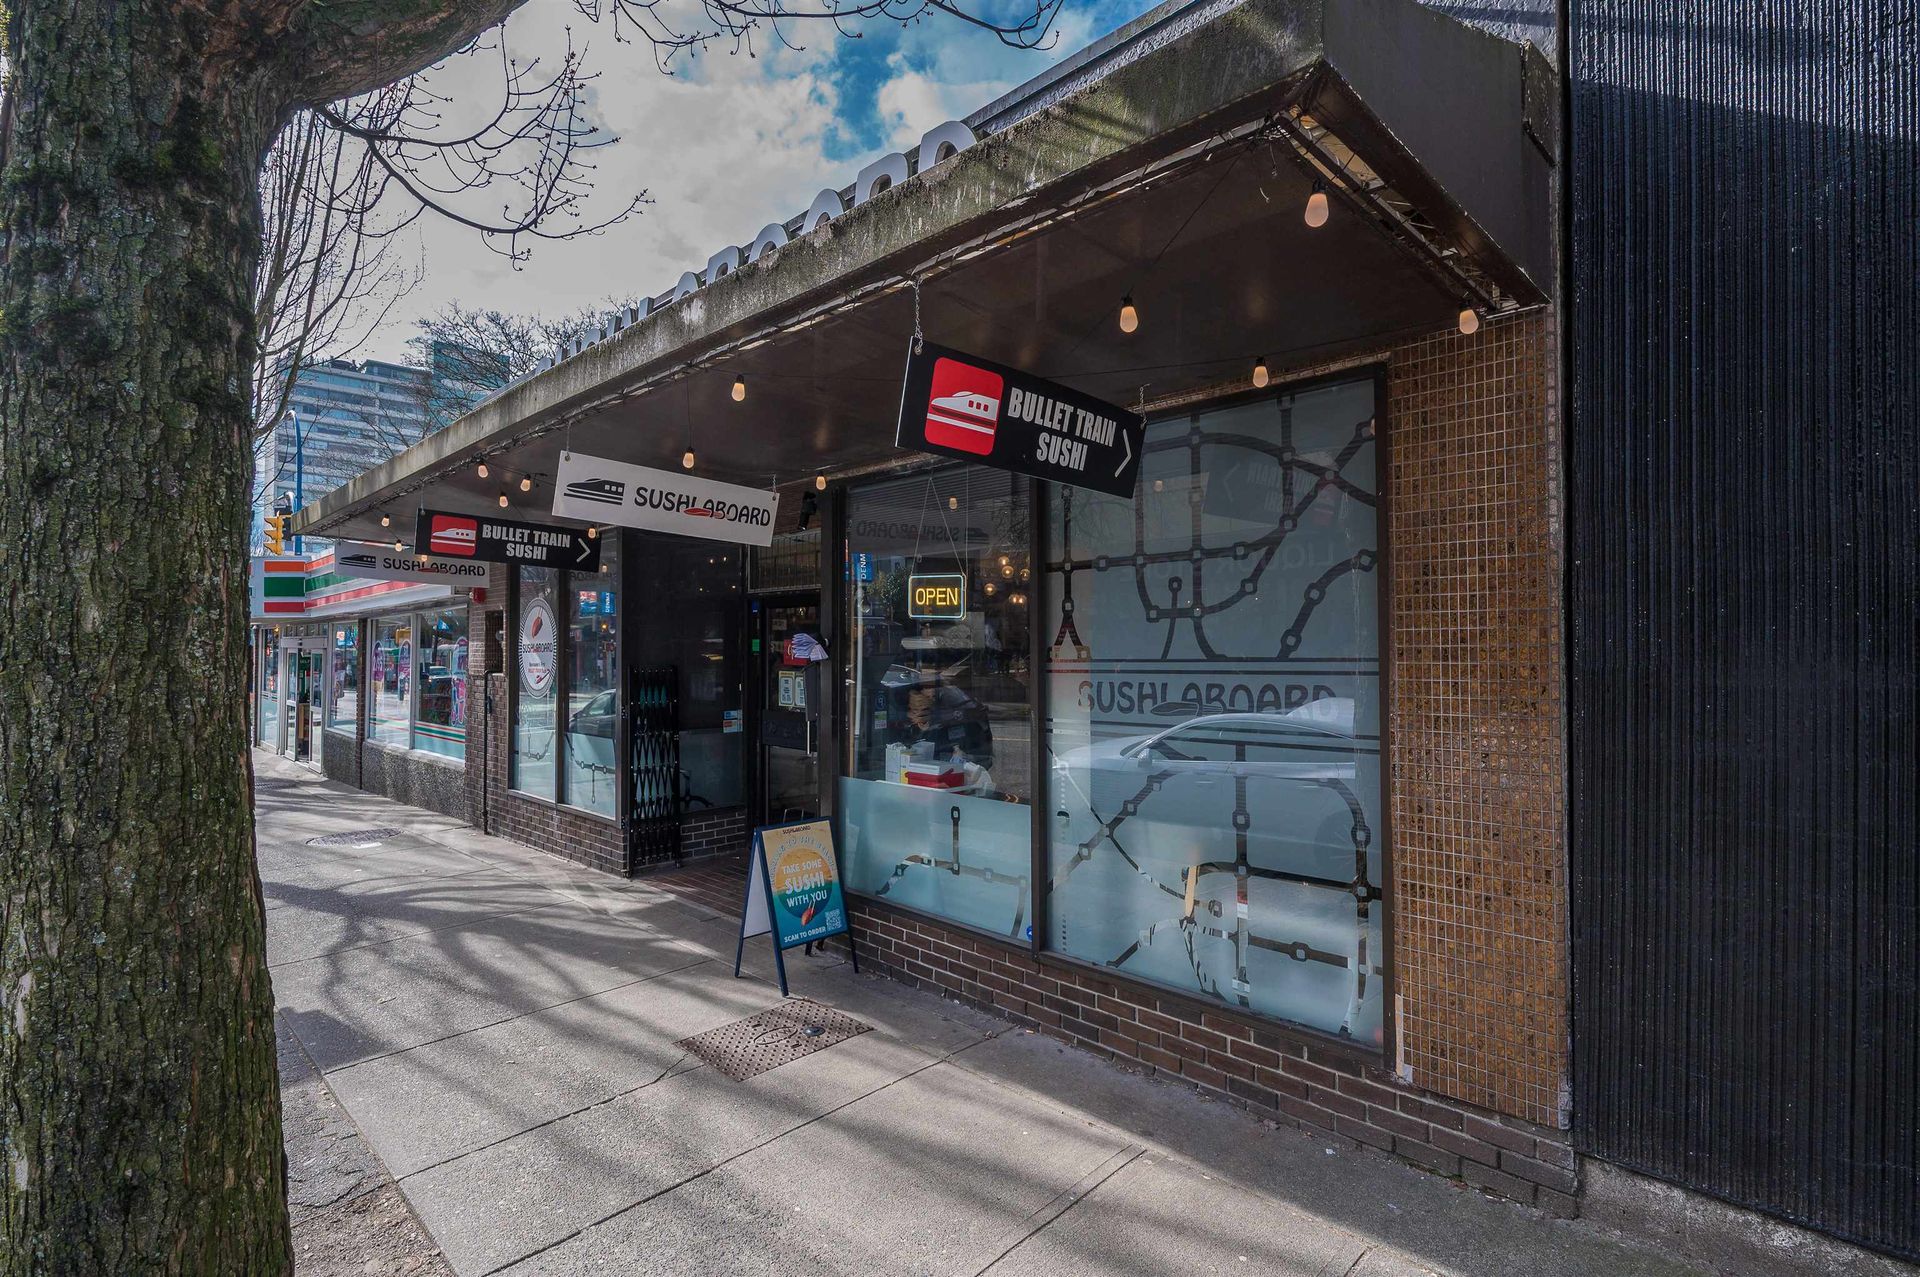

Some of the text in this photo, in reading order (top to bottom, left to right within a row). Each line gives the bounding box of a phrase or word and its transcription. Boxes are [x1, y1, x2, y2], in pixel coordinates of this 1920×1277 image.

[1007, 386, 1117, 448] BULLET TRAIN
[1036, 432, 1088, 471] SUSHI
[634, 486, 771, 527] SUSHI ABOARD
[482, 524, 571, 548] BULLET TRAIN
[506, 542, 547, 560] SUSHI
[915, 587, 959, 606] OPEN
[1078, 681, 1337, 718] SUSHI ABOARD
[783, 858, 822, 875] TAKE SOME
[785, 872, 825, 895] SUSHI
[786, 890, 827, 907] WITH YOU
[784, 926, 826, 942] SCAN TO ORDER
